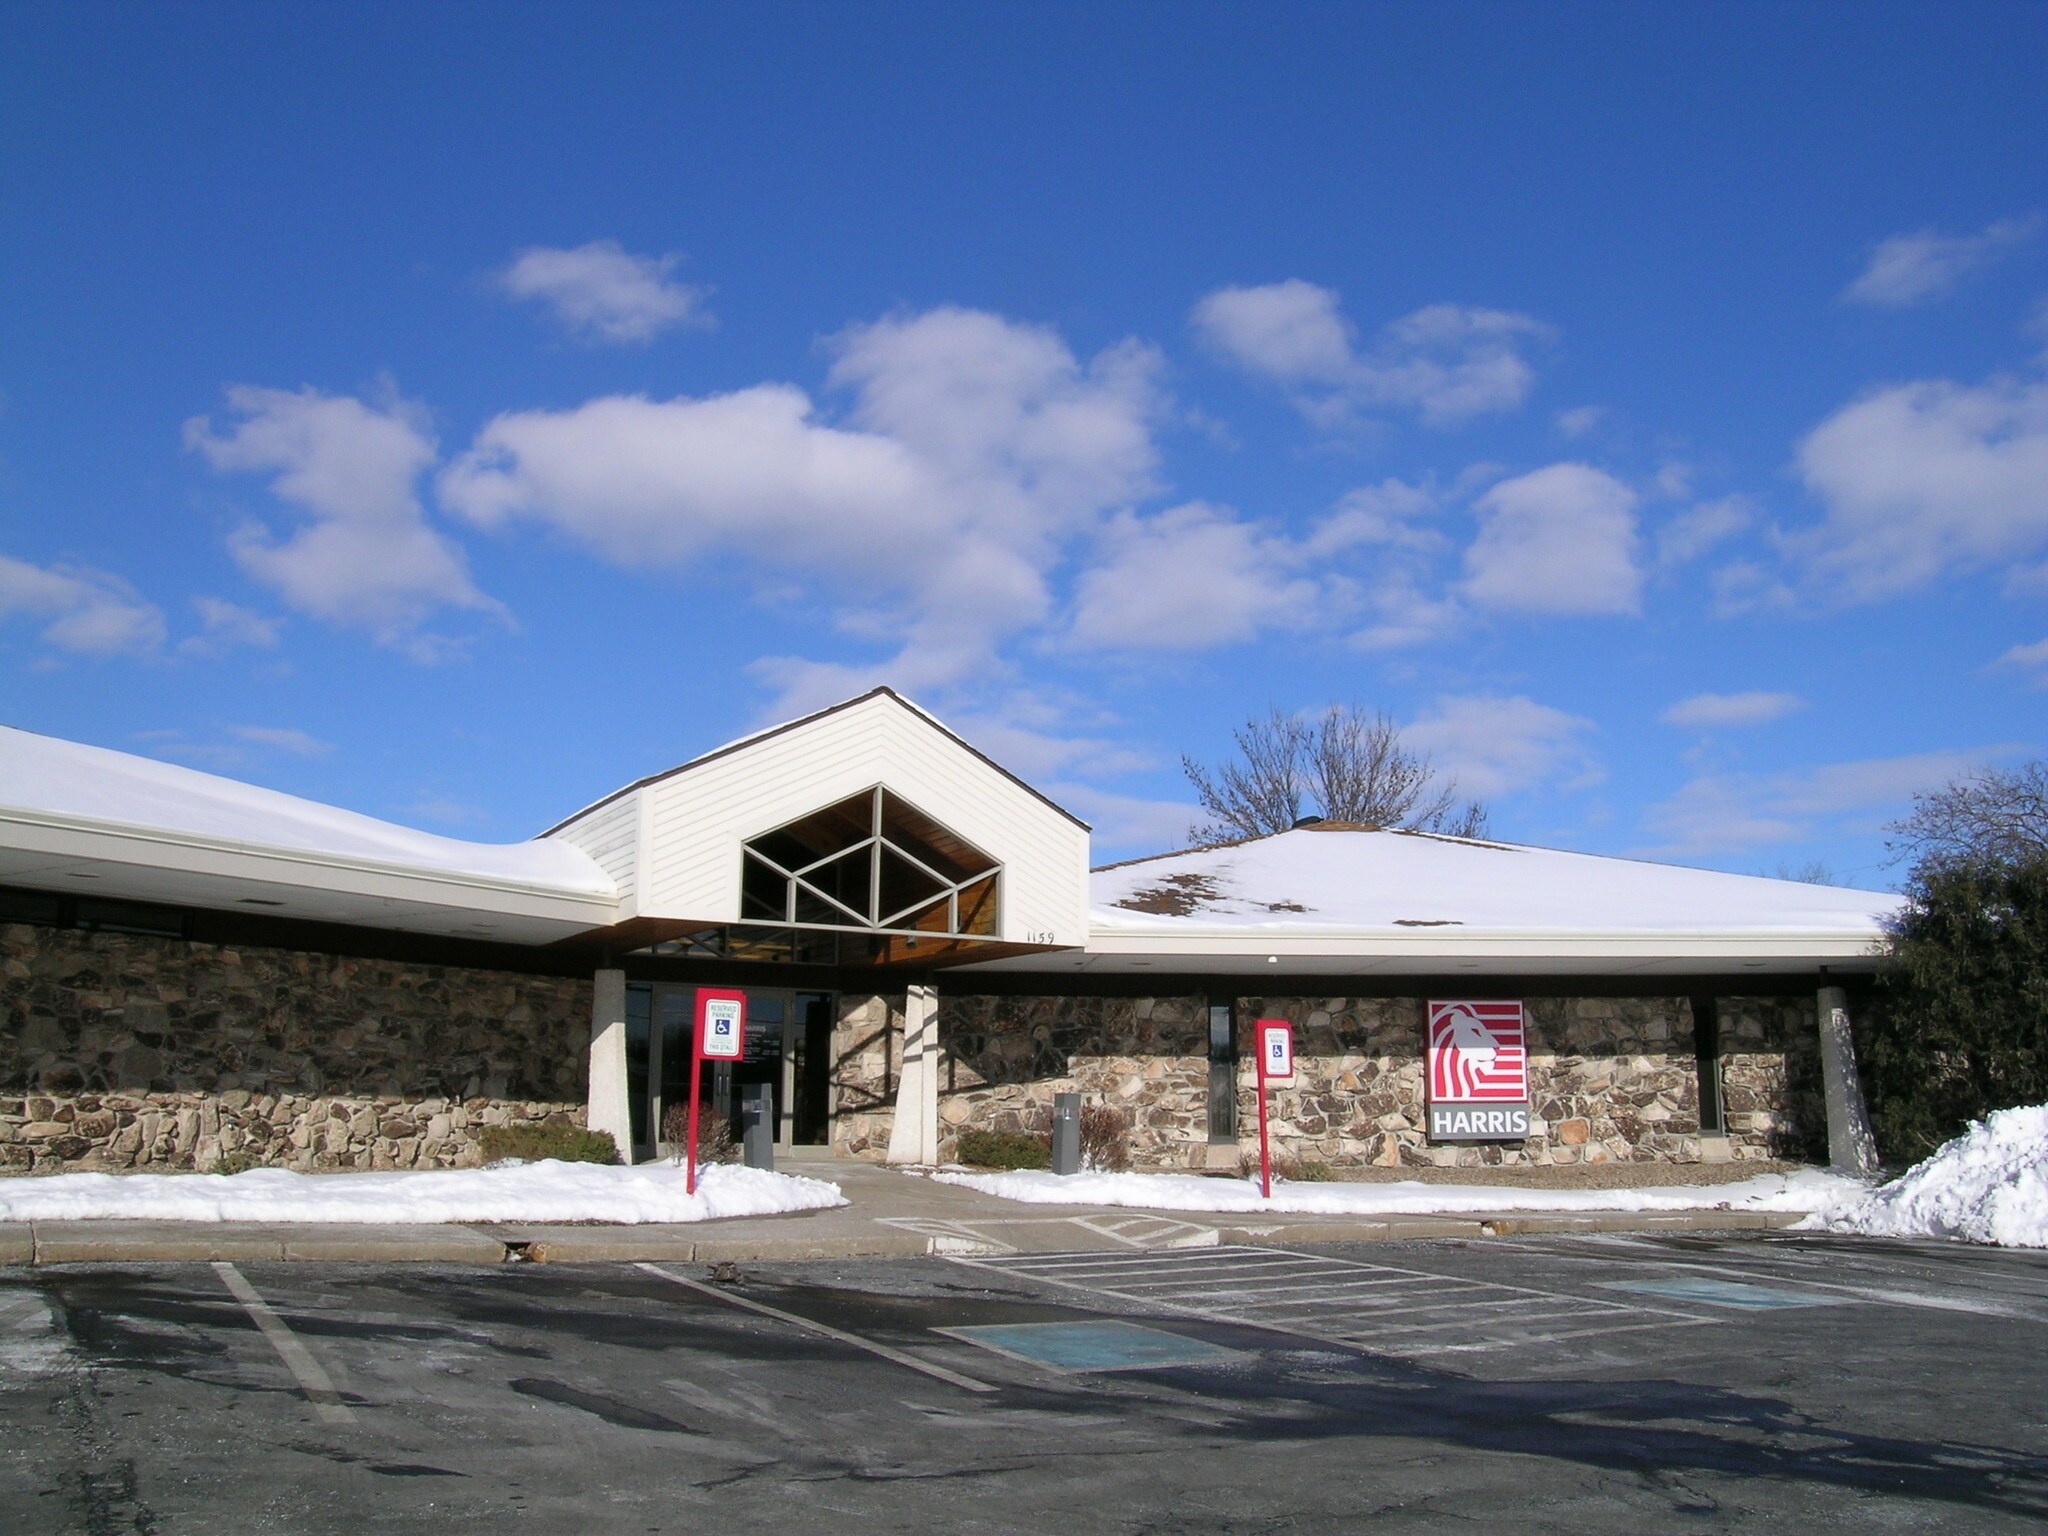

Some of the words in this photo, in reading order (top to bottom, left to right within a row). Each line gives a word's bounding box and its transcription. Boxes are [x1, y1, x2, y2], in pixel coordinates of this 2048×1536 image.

[1028, 931, 1054, 944] 1159
[711, 1004, 737, 1012] RESERVED
[1433, 1111, 1528, 1134] HARRIS
